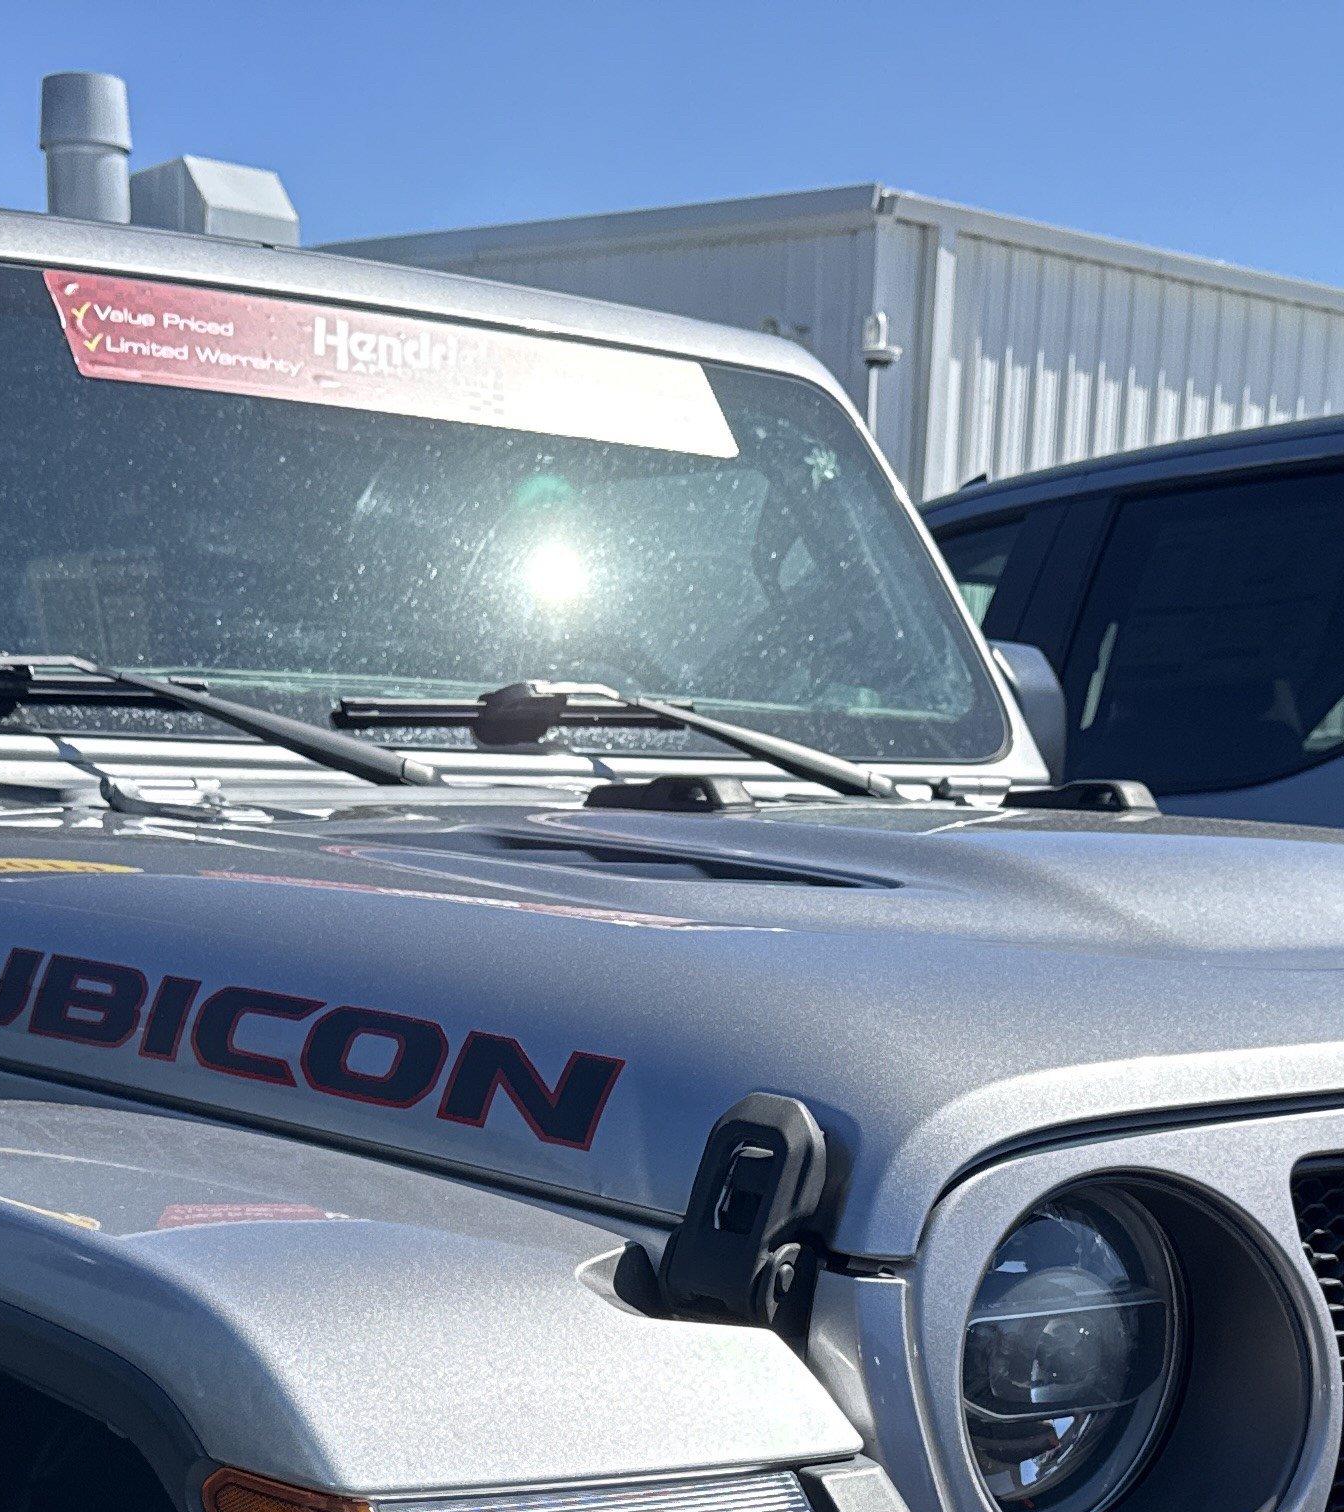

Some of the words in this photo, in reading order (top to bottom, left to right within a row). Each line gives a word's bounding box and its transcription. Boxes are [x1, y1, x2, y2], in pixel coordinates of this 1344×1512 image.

[93, 304, 155, 327] Value
[163, 312, 234, 337] Priced
[105, 335, 189, 361] Limited
[195, 345, 303, 377] Warranty
[314, 316, 494, 374] Hendri
